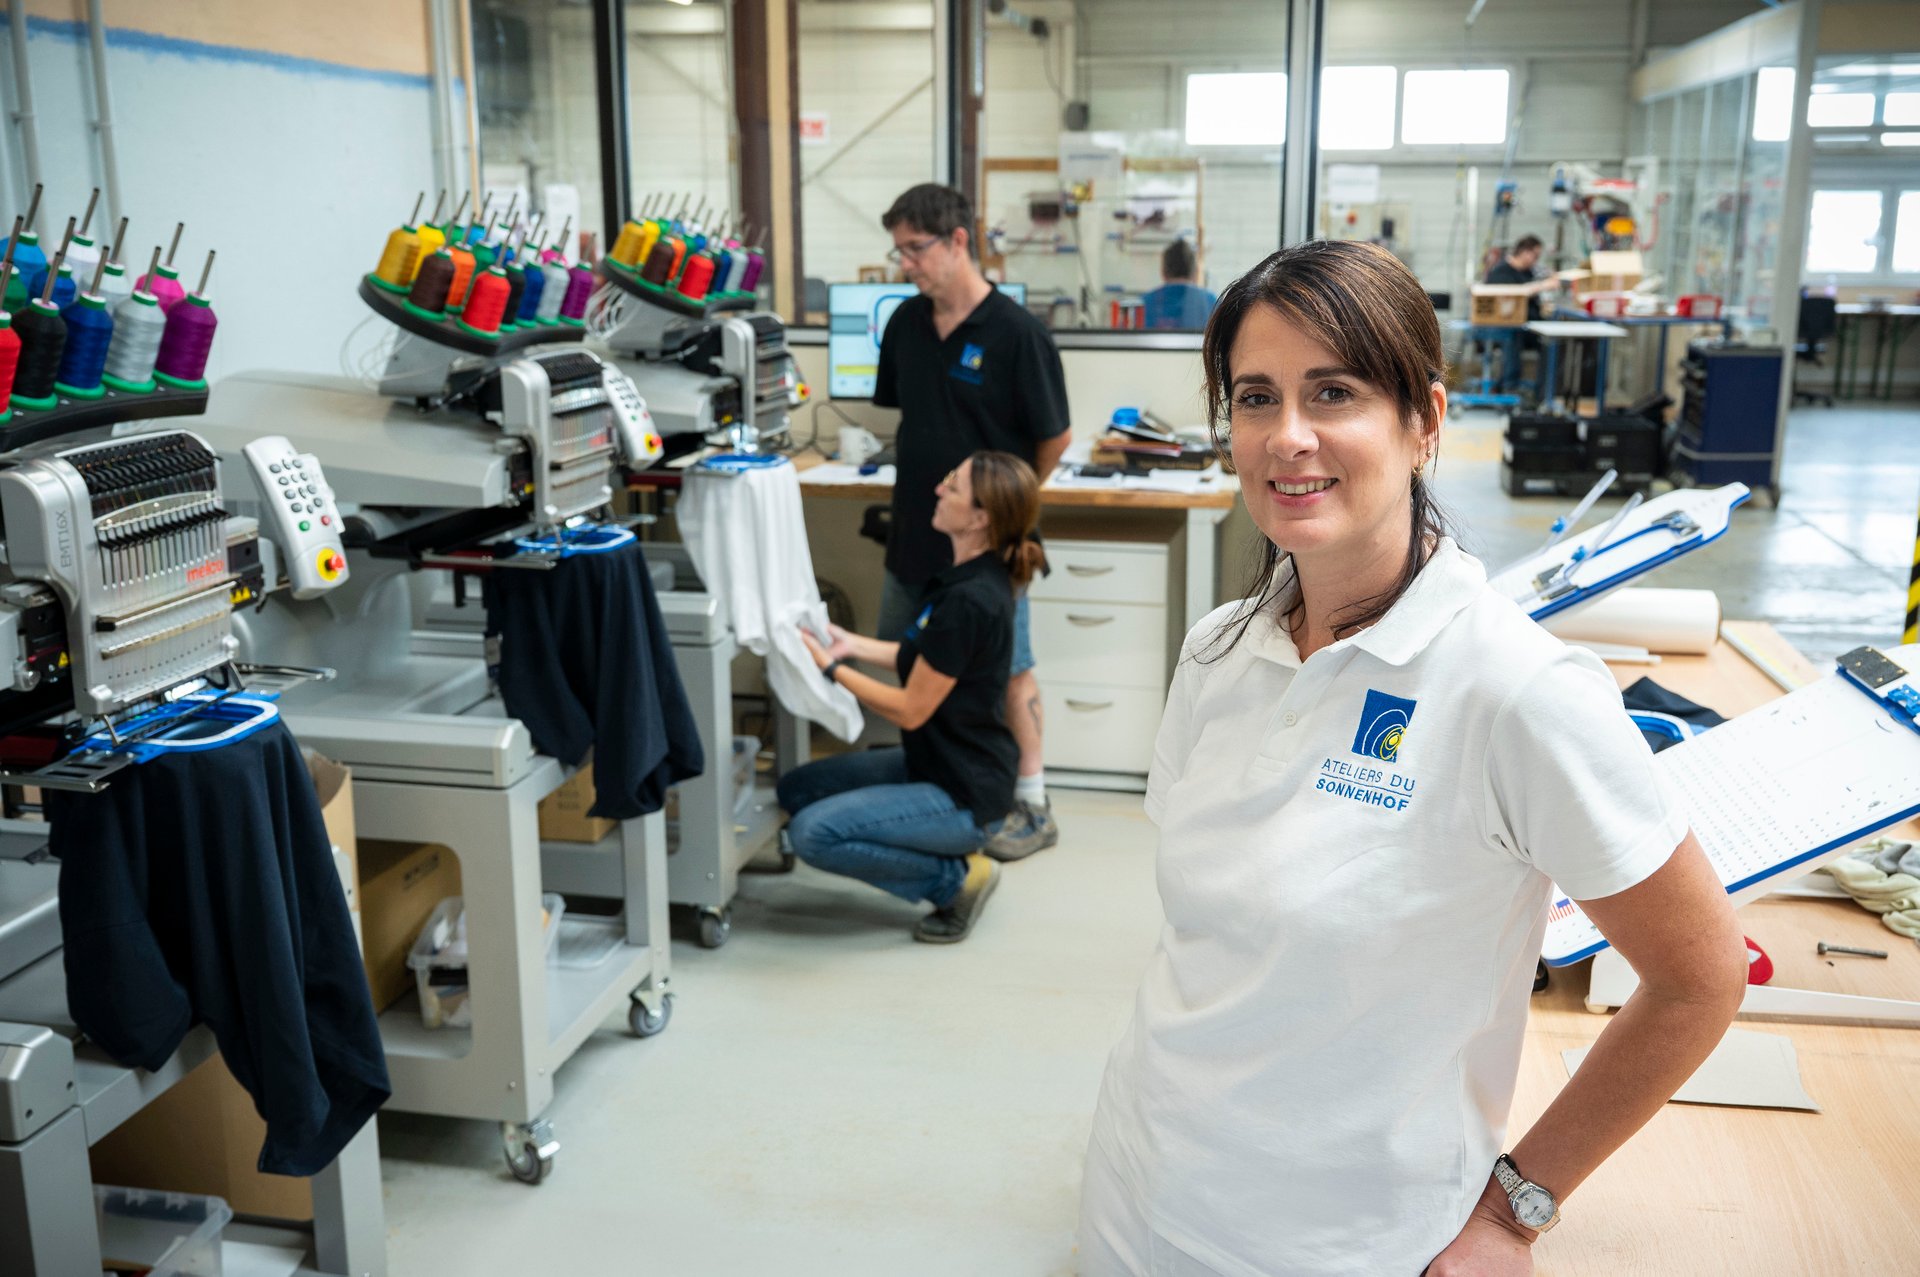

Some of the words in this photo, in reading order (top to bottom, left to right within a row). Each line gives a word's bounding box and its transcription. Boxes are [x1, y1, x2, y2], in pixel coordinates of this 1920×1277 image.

[56, 510, 72, 568] EMT16X
[186, 559, 225, 582] melco
[1321, 758, 1383, 783] ATELIERS
[1390, 774, 1416, 792] DU
[1316, 778, 1409, 811] SONNENHOF
